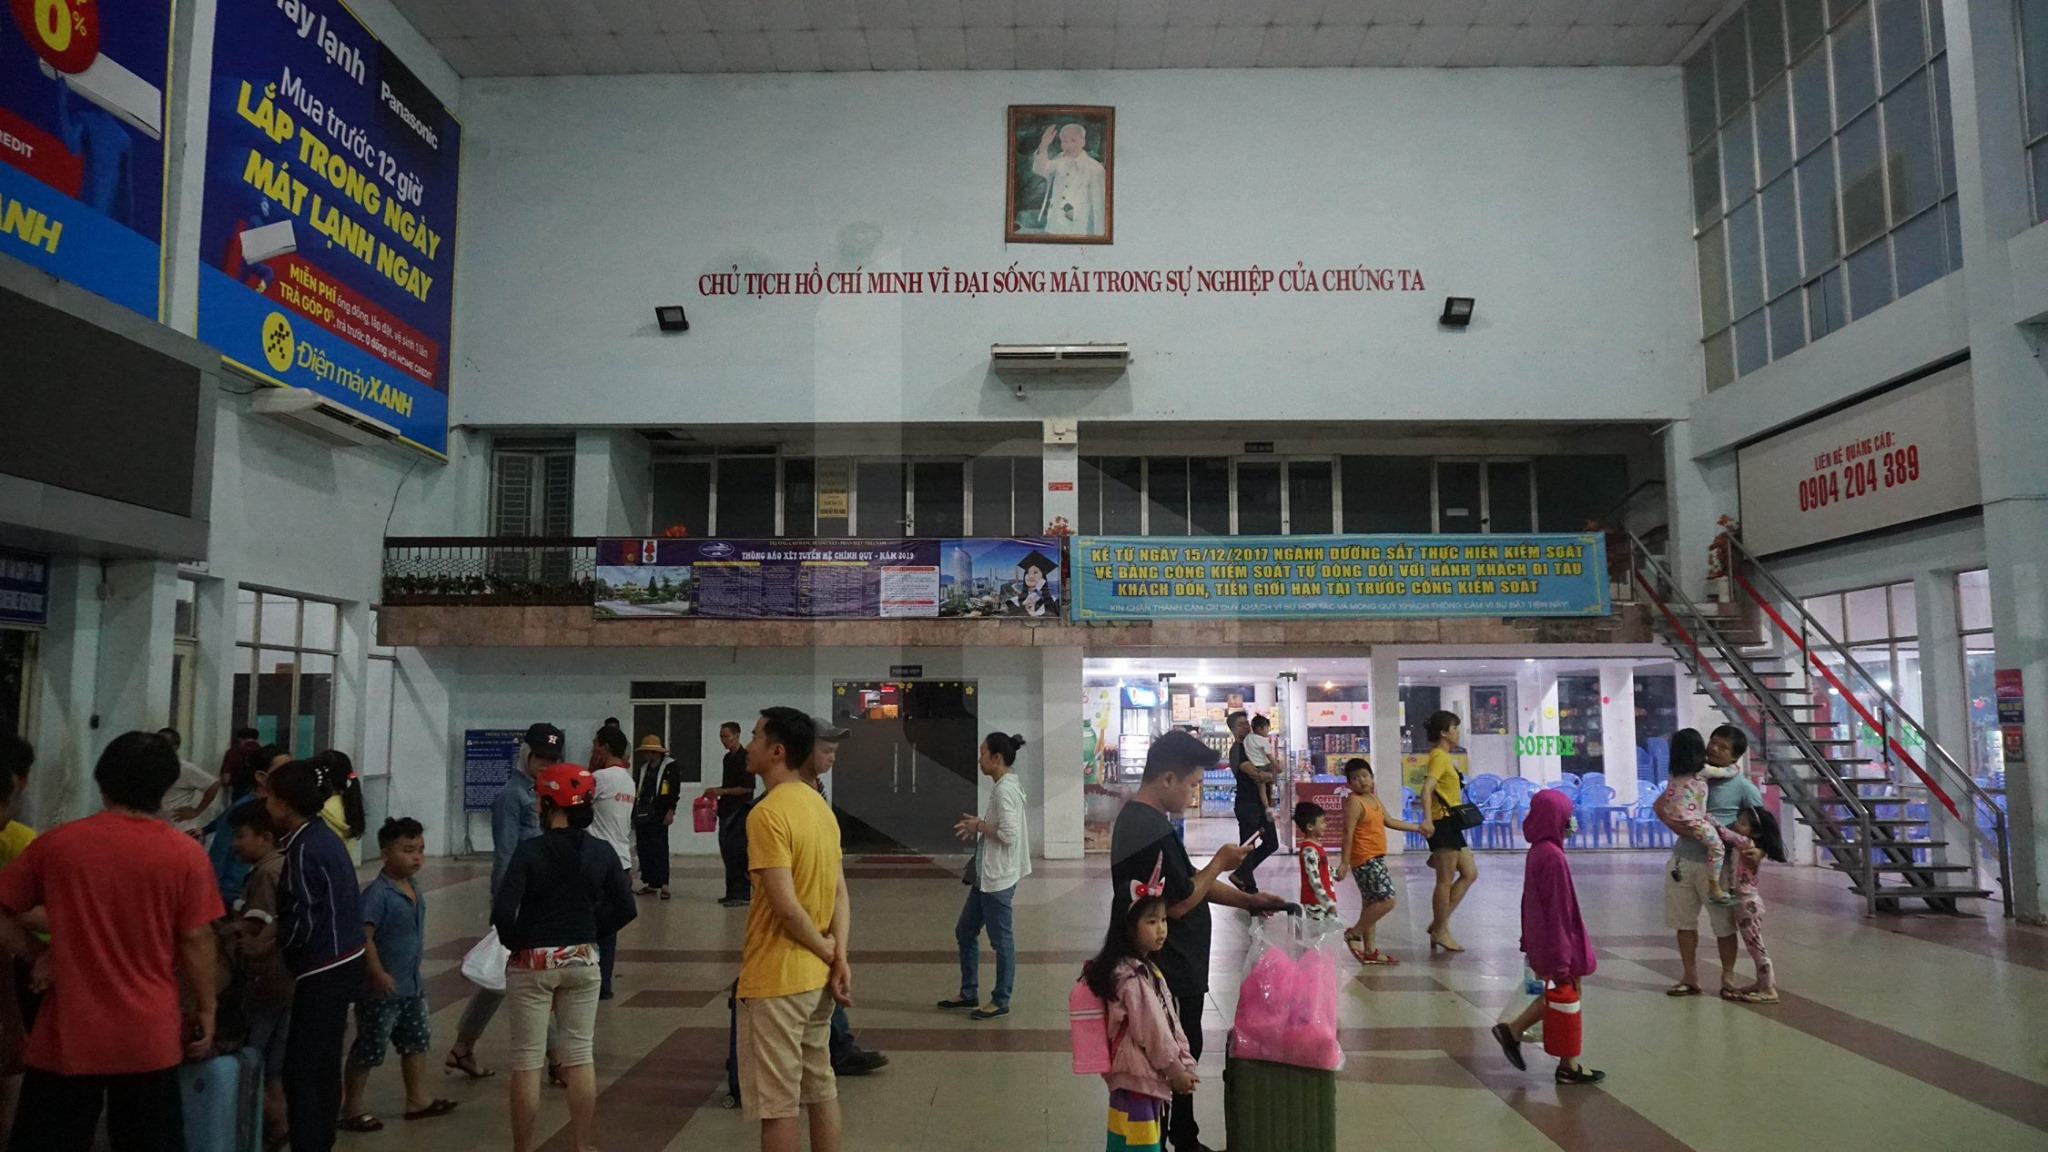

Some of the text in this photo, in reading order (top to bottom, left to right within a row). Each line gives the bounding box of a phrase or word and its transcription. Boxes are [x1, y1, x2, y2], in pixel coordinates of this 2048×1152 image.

[317, 15, 366, 86] lạnh
[381, 80, 438, 150] Panasonic
[280, 66, 424, 207] Mua trước 12 giờ
[237, 80, 441, 261] LẮP TRONG NGÀY
[243, 149, 434, 302] MÁT LẠNH NGAY
[280, 281, 301, 307] TRẢ
[301, 294, 323, 317] GÓP
[290, 263, 317, 291] MIỄN
[319, 282, 337, 303] PHÍ
[699, 261, 1425, 299] CHỦ TỊCH HỒ CHÍ MINH VĨ ĐẠI SỐNG MÃI TRONG SỰ NGHIỆP CỦA CHÚNG TA
[297, 340, 335, 381] Điện
[1799, 444, 1920, 512] 0904 204 389
[1814, 452, 1831, 471] LIÊN
[741, 551, 765, 560] THÔNG
[767, 550, 782, 560] BÁO
[834, 550, 857, 560] CHÍNH
[858, 551, 873, 561] QUY
[898, 551, 914, 560] 2019
[1184, 547, 1268, 562] 15/12/2017
[1532, 562, 1548, 575] ĐI
[1291, 581, 1322, 598] HẠN
[1327, 581, 1351, 598] TẠI
[1514, 735, 1576, 757] COFFEE
